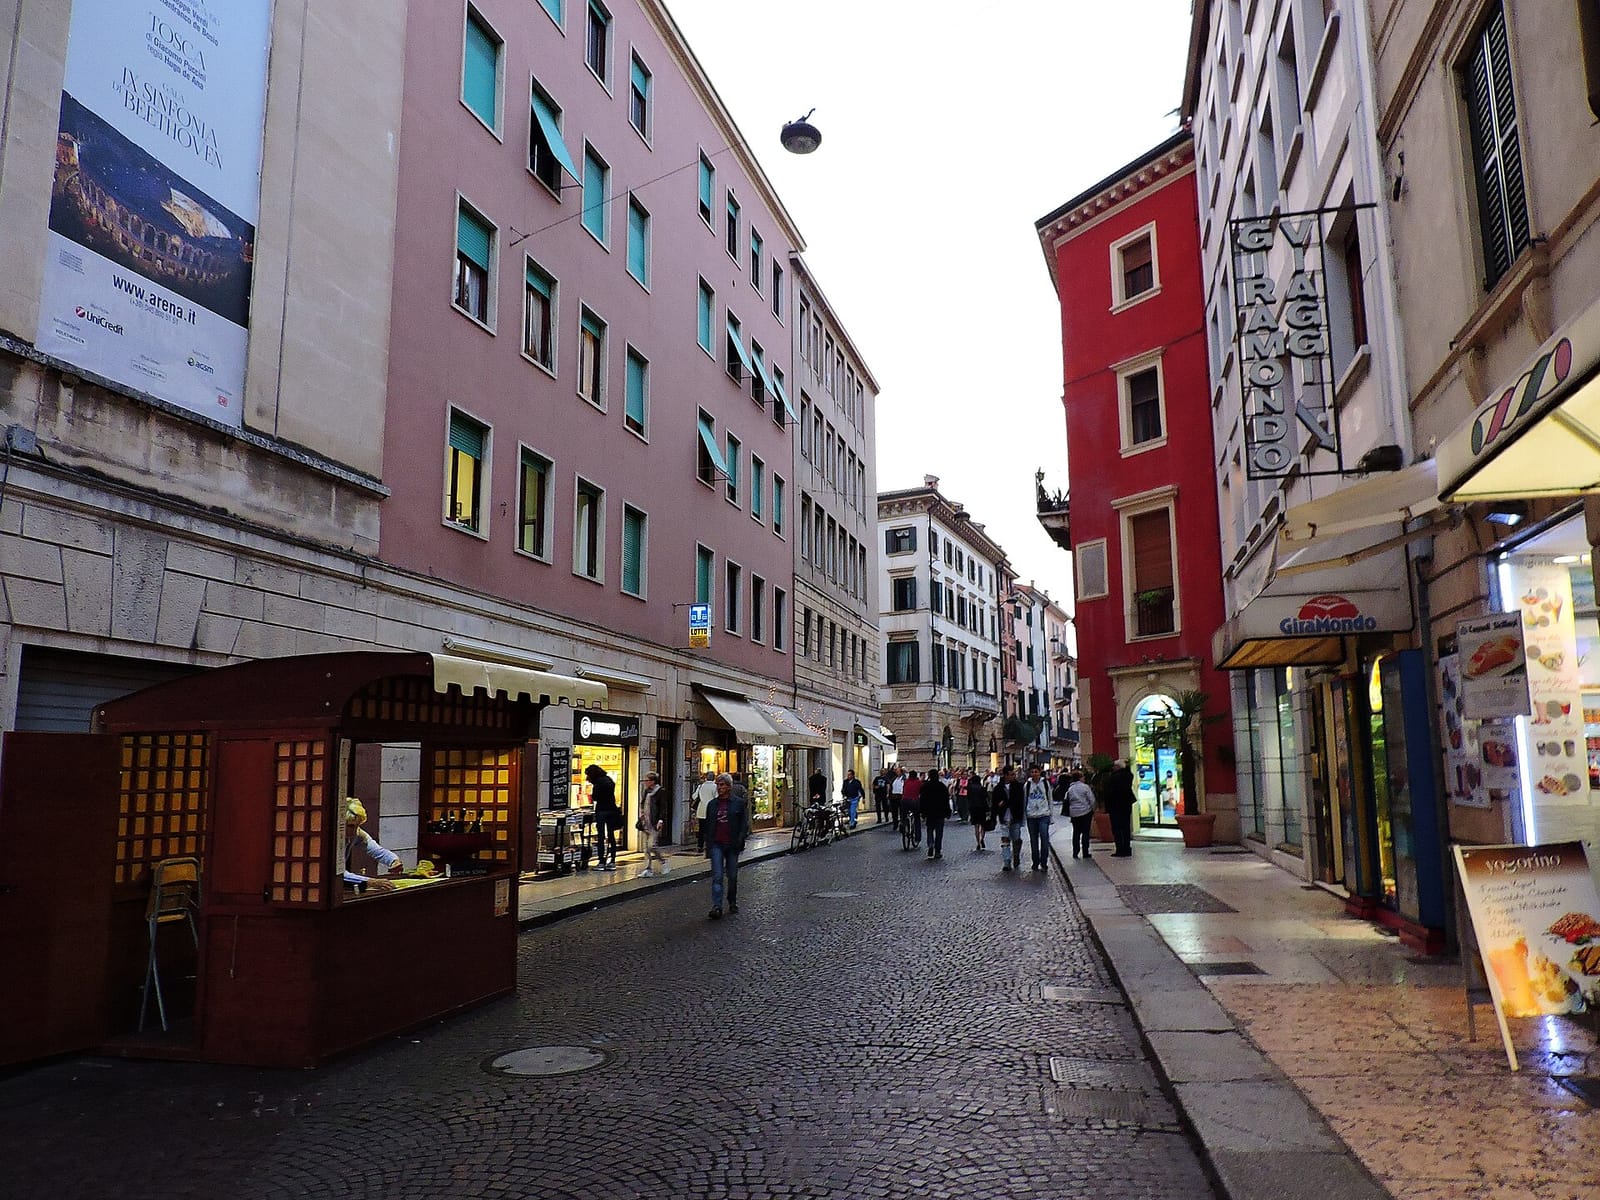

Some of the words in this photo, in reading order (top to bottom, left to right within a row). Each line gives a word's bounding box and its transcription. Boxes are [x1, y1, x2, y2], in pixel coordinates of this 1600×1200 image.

[149, 12, 206, 71] TOSCA
[153, 36, 183, 64] Giacomo
[124, 89, 223, 170] BEETHOVEN
[142, 82, 218, 149] SINFONIA
[86, 311, 125, 336] UniCredit
[112, 274, 197, 326] www.arena.it
[1278, 219, 1327, 386] VIAGGI
[1236, 222, 1292, 471] GIRAMONDO
[1279, 615, 1377, 634] GiraMondo
[1485, 852, 1561, 876] yogorino
